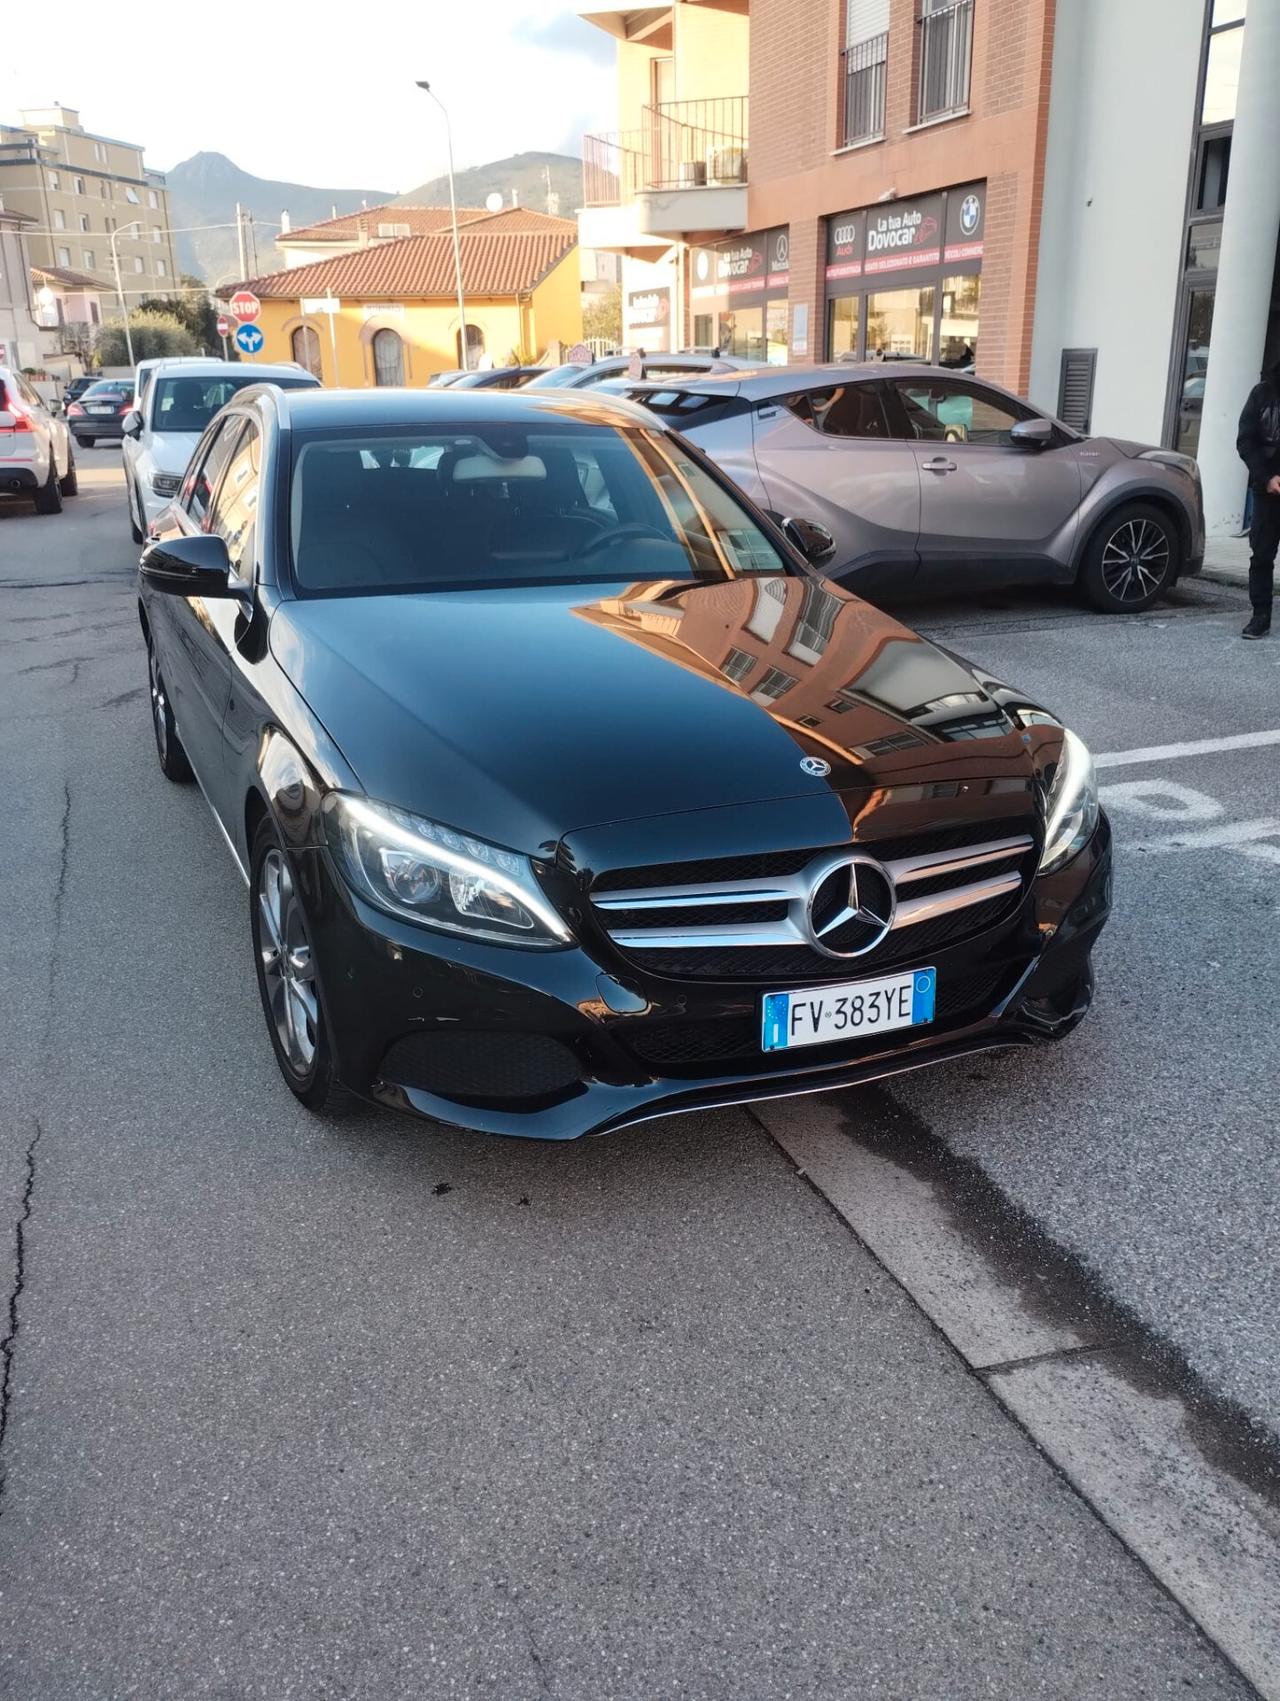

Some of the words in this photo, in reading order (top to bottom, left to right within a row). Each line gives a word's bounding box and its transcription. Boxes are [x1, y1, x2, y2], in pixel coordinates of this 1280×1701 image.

[877, 217, 888, 232] La
[888, 215, 901, 230] tua
[902, 210, 922, 226] Auto
[868, 226, 916, 251] Dovocar
[836, 244, 853, 256] Audi
[233, 302, 258, 314] STOP
